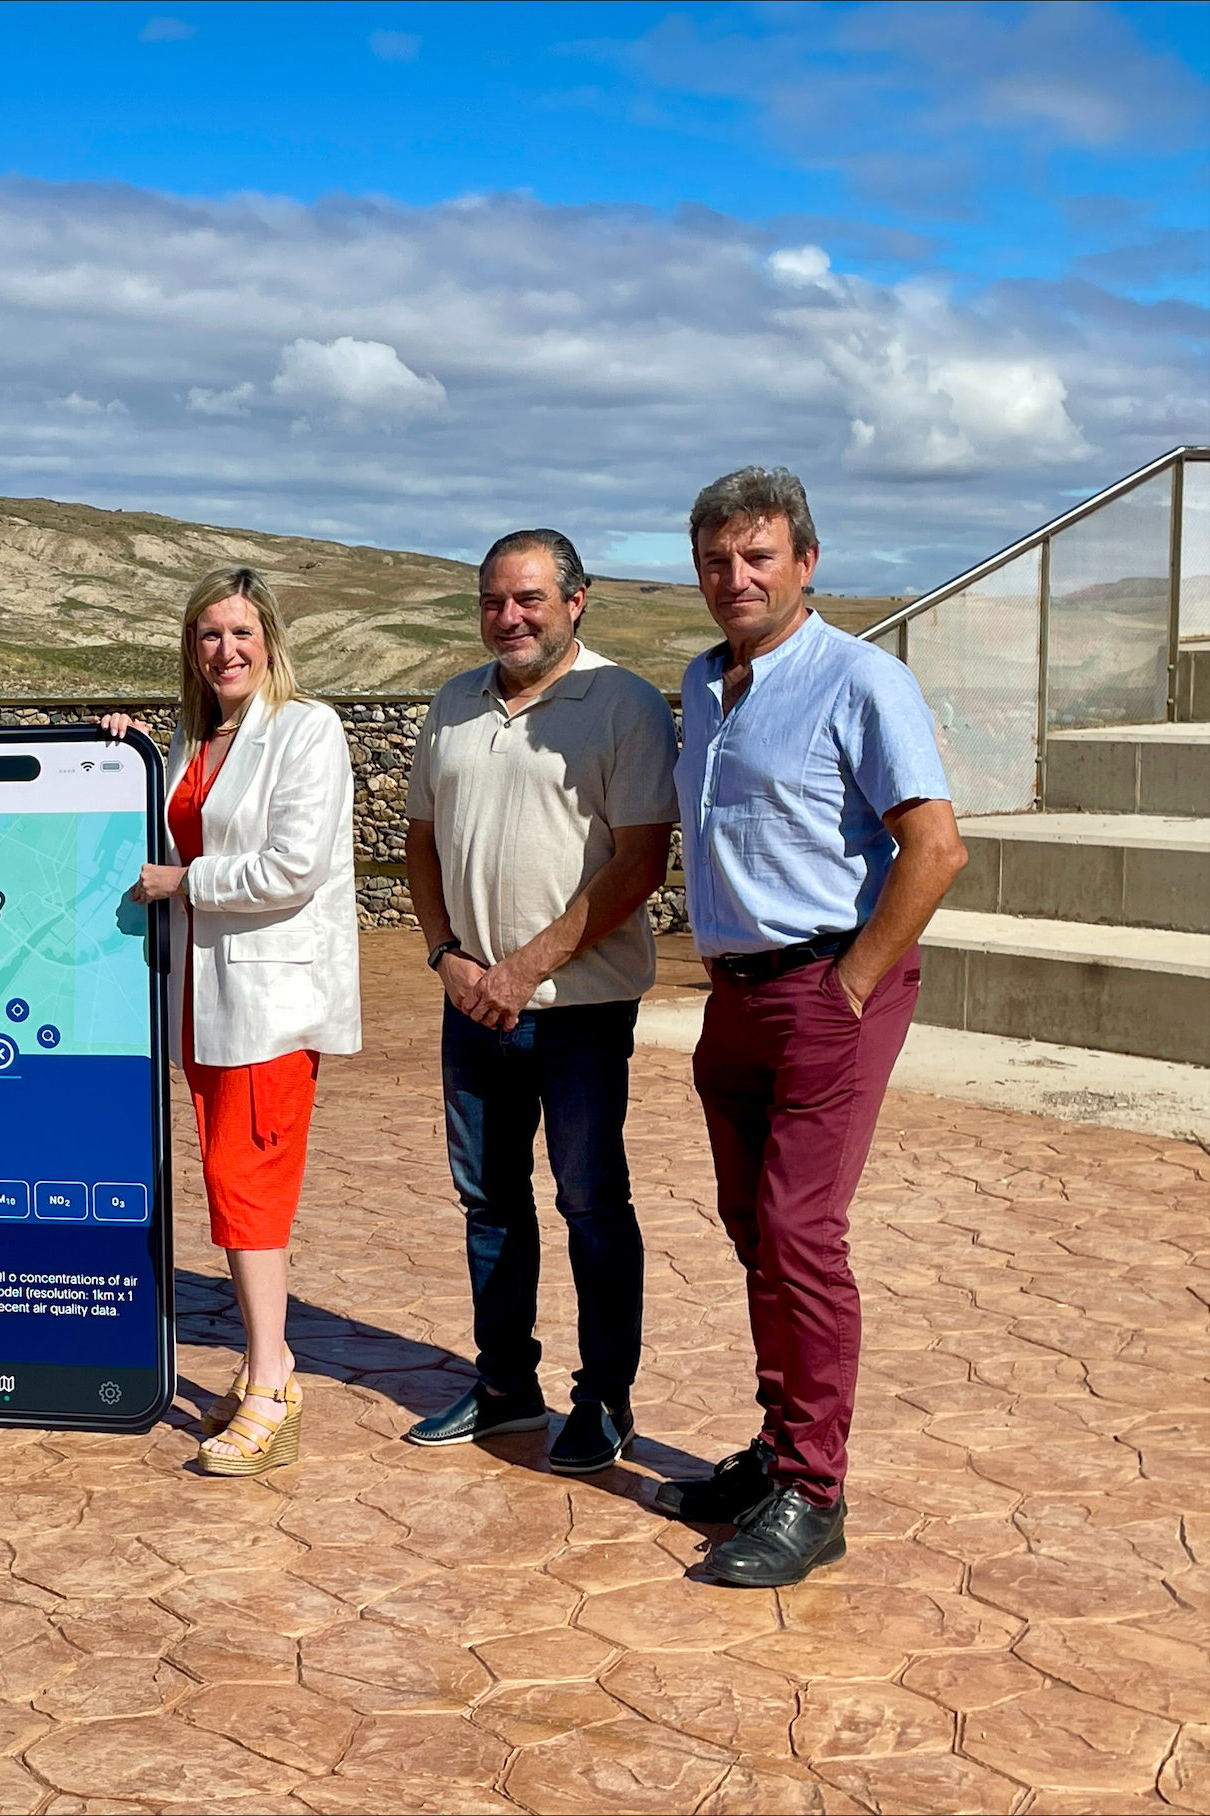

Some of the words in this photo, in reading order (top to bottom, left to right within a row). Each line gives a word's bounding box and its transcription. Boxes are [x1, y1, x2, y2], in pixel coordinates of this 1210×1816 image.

[9, 1274, 17, 1282] o
[19, 1273, 105, 1285] concentrations
[108, 1275, 120, 1286] of
[123, 1276, 138, 1287] air
[26, 1287, 89, 1300] (resolution:
[92, 1290, 115, 1301] 1km
[117, 1293, 125, 1301] x
[128, 1290, 133, 1302] 1
[33, 1303, 47, 1314] air
[50, 1303, 88, 1317] quality
[91, 1305, 120, 1317] data.
